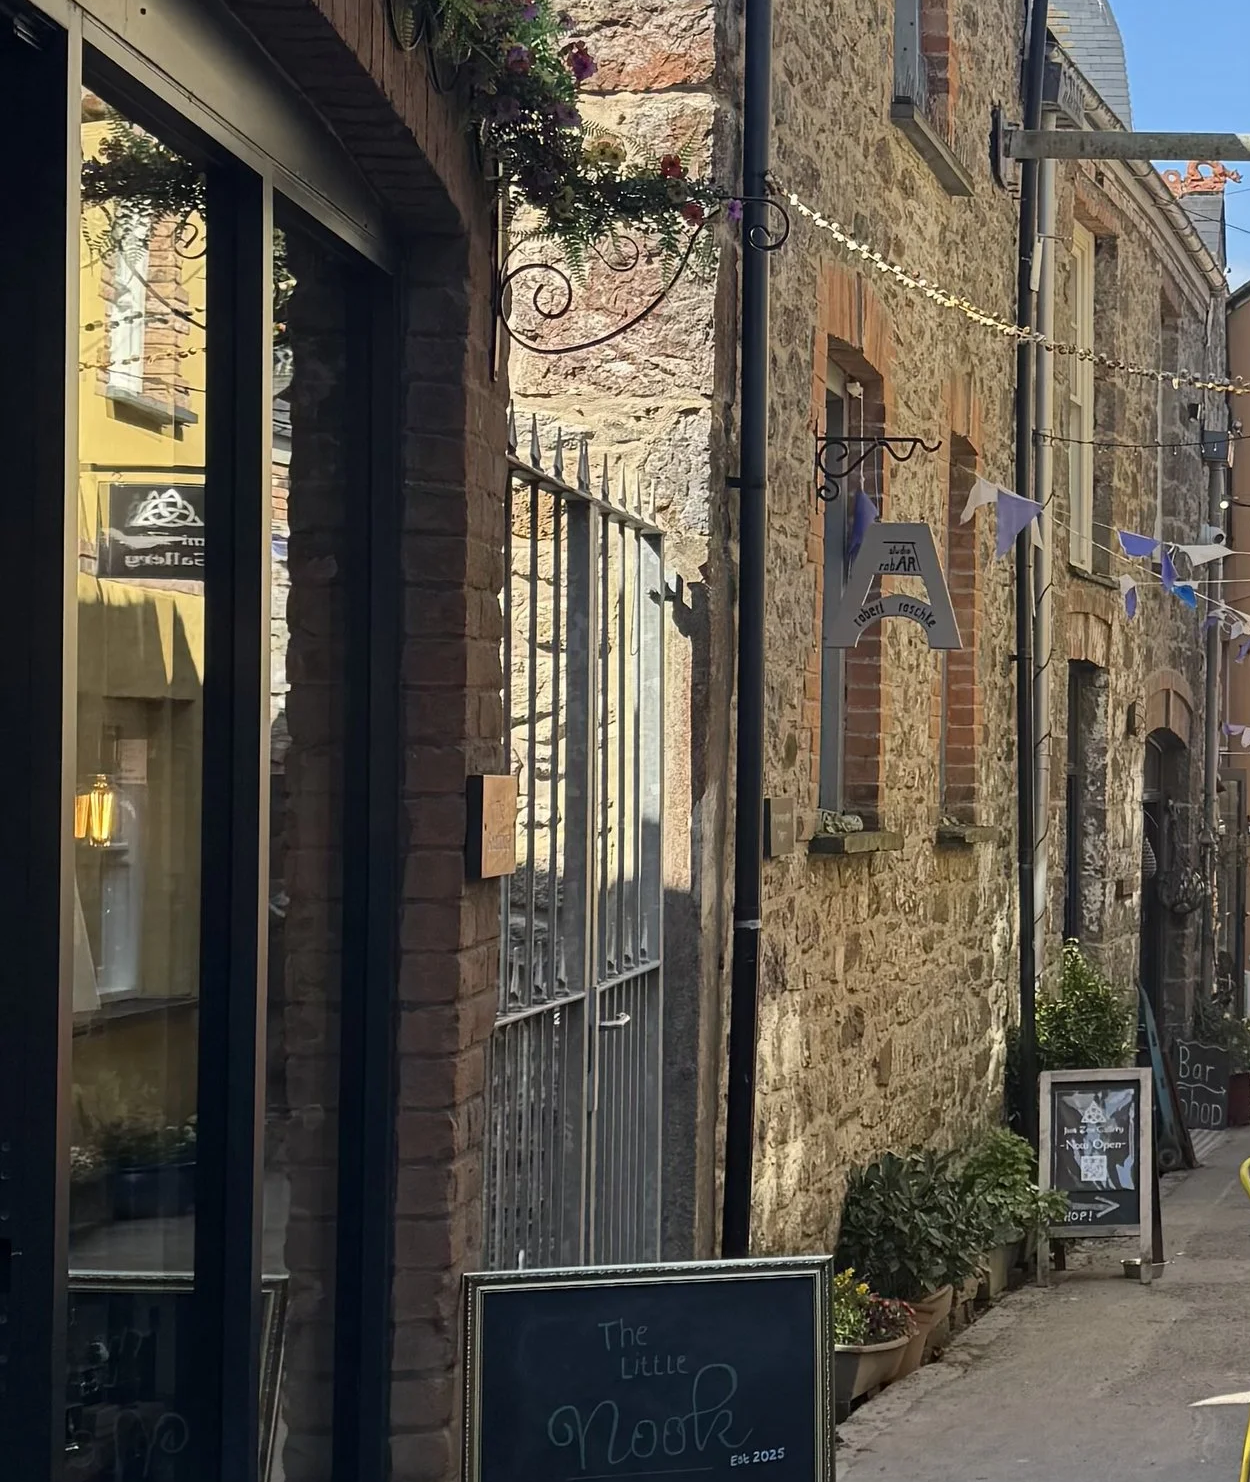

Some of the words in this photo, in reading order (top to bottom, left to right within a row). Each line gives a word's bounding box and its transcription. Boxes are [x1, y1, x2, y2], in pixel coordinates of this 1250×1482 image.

[1179, 1046, 1215, 1083] Bar
[598, 1318, 648, 1351] The
[730, 1451, 750, 1466] Est
[753, 1447, 785, 1464] 2025
